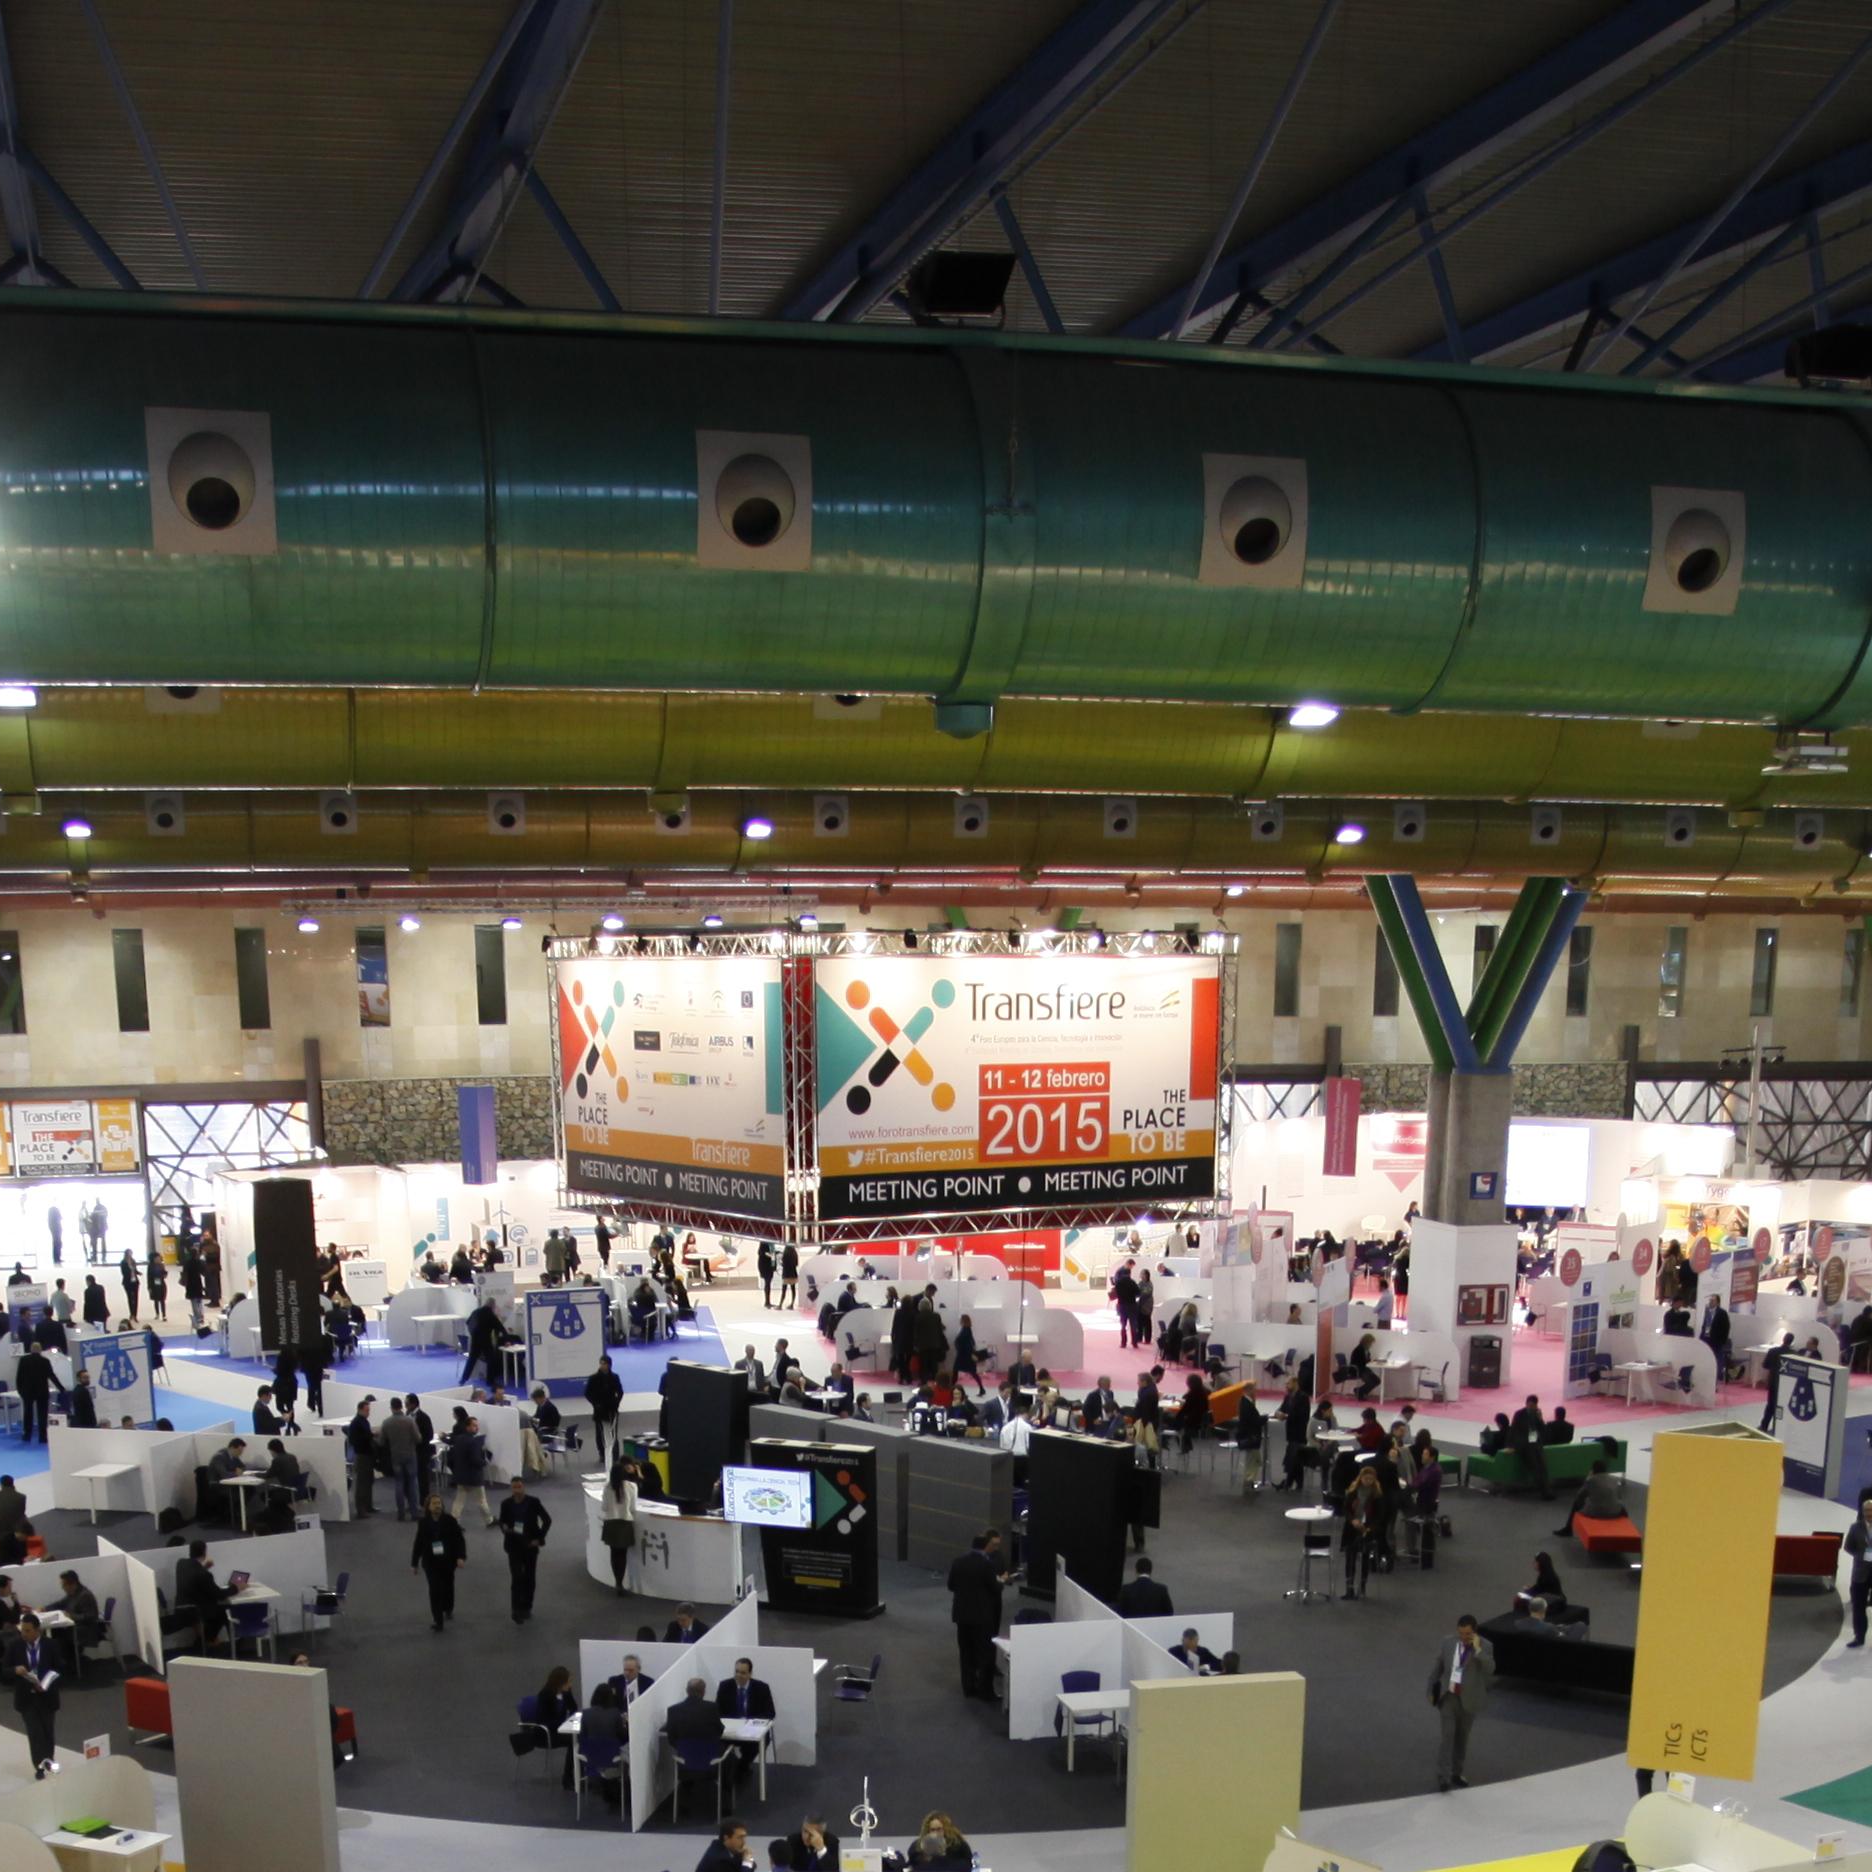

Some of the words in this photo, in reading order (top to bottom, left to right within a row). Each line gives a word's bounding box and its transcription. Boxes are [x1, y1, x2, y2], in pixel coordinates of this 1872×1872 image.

[964, 982, 1126, 1022] Transfiere
[984, 1071, 1001, 1089] 11
[1021, 1069, 1042, 1088] 12
[1046, 1067, 1105, 1088] febrero
[595, 1092, 607, 1105] THE
[1163, 1089, 1186, 1104] THE
[21, 1110, 82, 1123] Transfiere
[579, 1106, 608, 1125] PLACE
[1123, 1107, 1186, 1130] PLACE
[35, 1132, 54, 1142] THE
[581, 1126, 594, 1144] TO
[596, 1128, 609, 1145] BE
[849, 1124, 974, 1140] www.forotransfiere.com
[985, 1101, 1103, 1157] 2015
[20, 1143, 55, 1153] PLACE
[691, 1138, 751, 1167] Transfiere
[1128, 1132, 1155, 1154] TO
[1163, 1130, 1185, 1152] BE
[864, 1147, 975, 1166] #Transfiere2015
[580, 1160, 623, 1182] MEETING
[626, 1165, 658, 1186] POINT
[679, 1173, 728, 1196] MEETING
[731, 1178, 768, 1201] POINT
[848, 1178, 937, 1203] MEETING
[944, 1174, 1006, 1196] POINT
[1044, 1168, 1126, 1192] MEETING
[1132, 1164, 1188, 1186] POINT
[276, 1269, 284, 1316] Rotatorias
[278, 1317, 287, 1345] Mesas
[1664, 1722, 1683, 1758] TICs
[1690, 1728, 1709, 1762] ICTs
